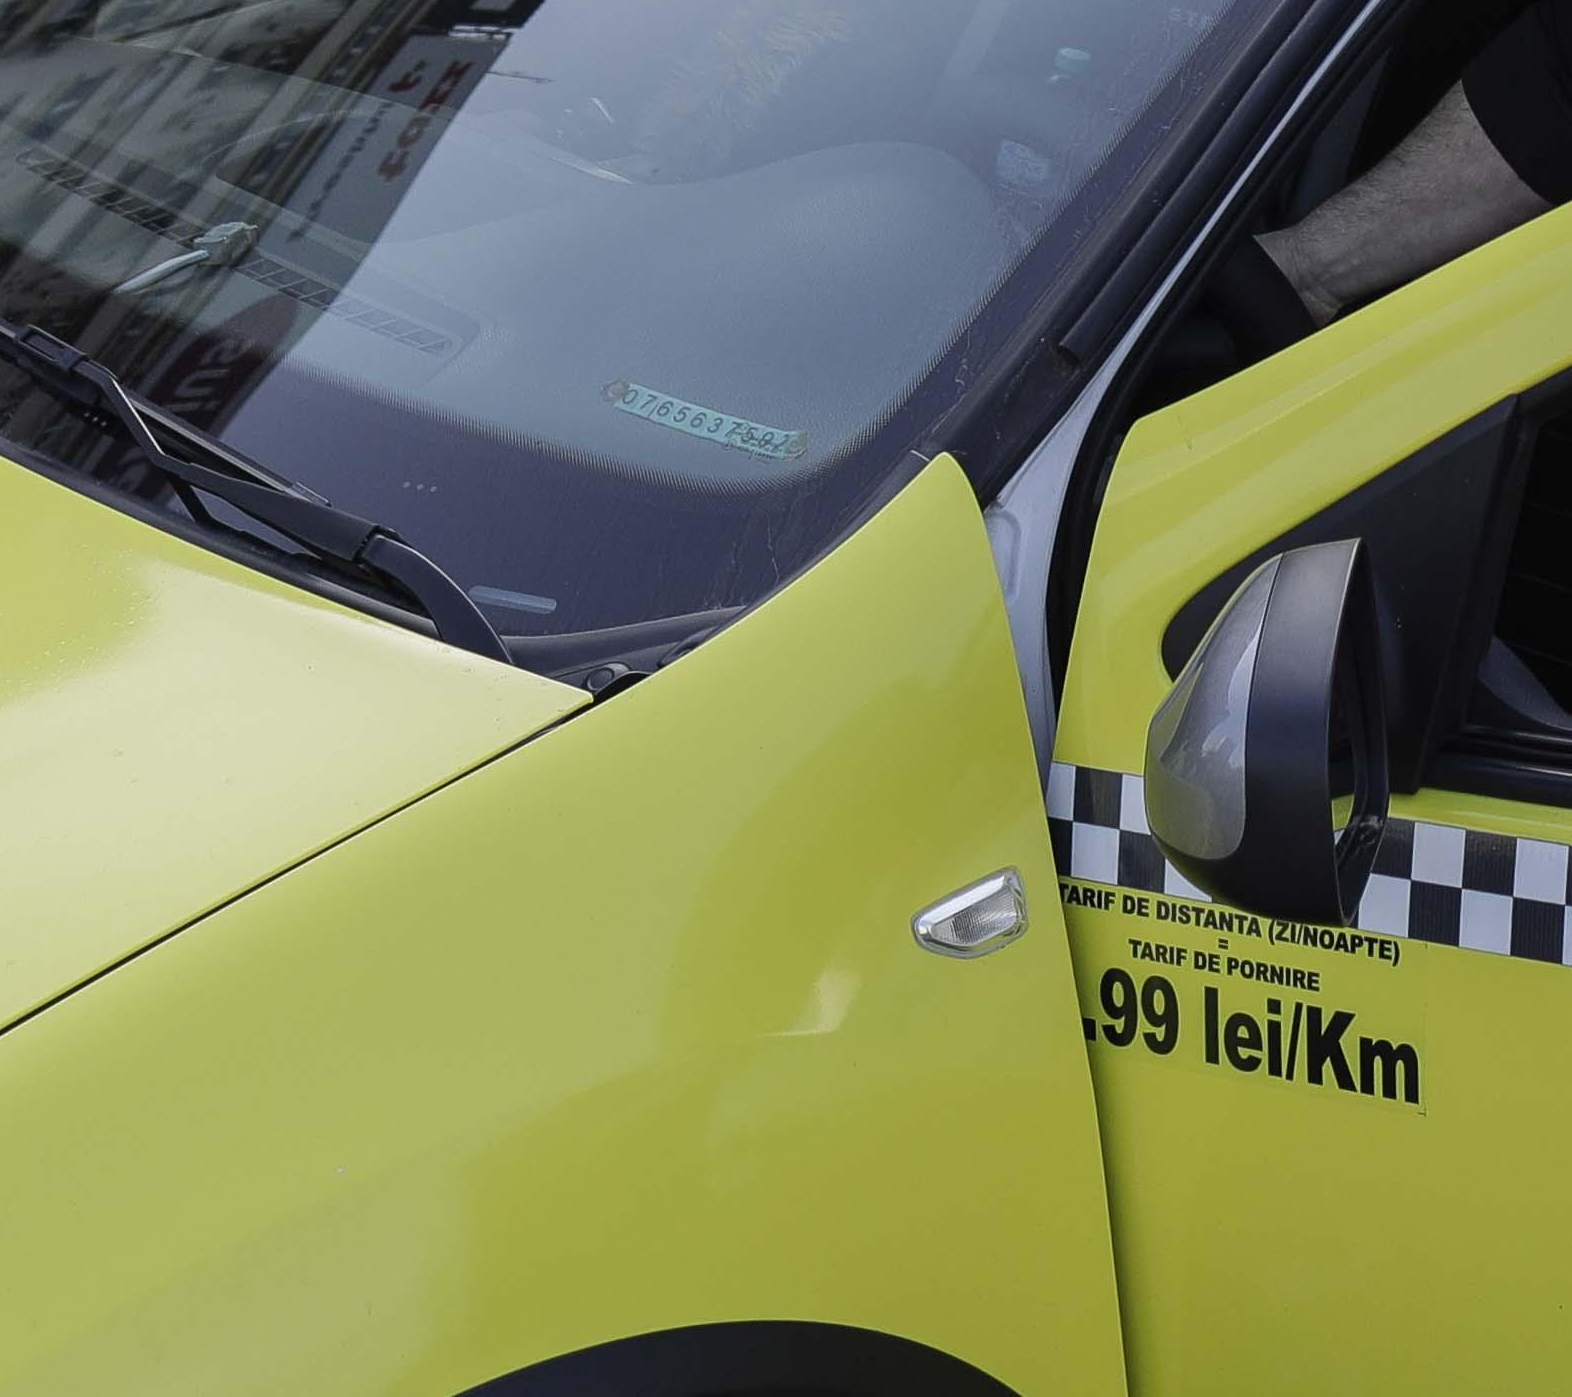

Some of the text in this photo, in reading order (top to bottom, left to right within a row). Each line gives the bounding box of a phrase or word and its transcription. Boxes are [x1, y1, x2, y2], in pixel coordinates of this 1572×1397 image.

[1123, 894, 1150, 918] DE
[1156, 900, 1262, 938] DISTANTA
[1128, 939, 1320, 992] TARIF DE PORNIRE
[1081, 967, 1420, 1106] .99 lei/Km
